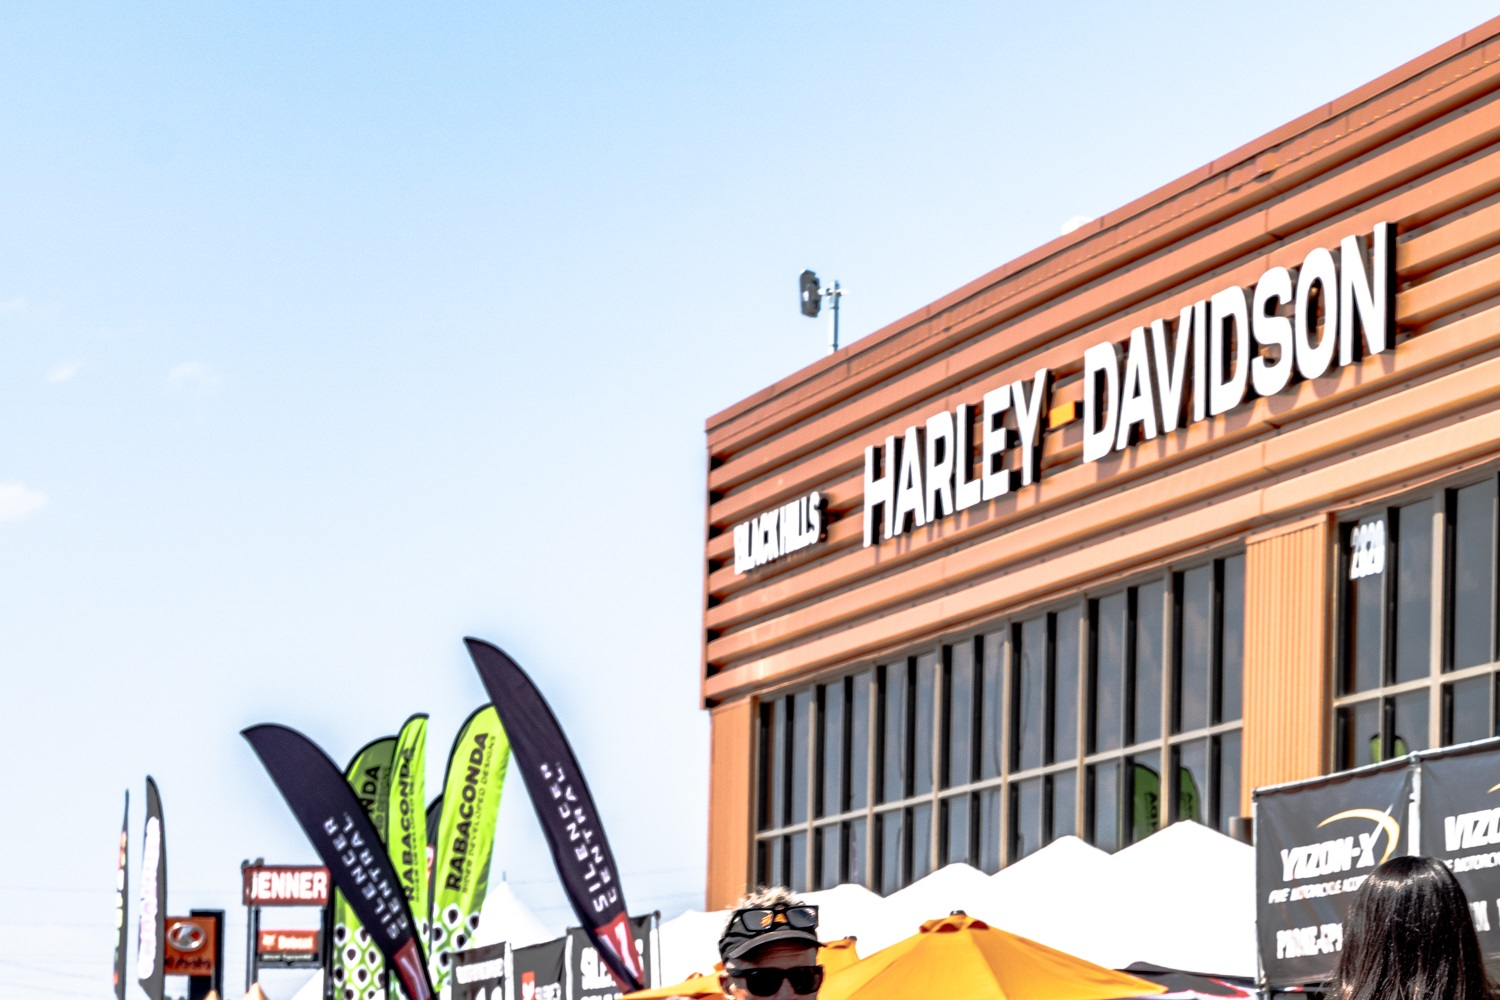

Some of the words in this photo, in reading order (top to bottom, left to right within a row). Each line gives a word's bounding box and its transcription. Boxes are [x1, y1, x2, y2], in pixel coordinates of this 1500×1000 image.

[734, 509, 779, 576] BLACK
[779, 490, 820, 557] HILLS
[445, 731, 489, 892] RABACONDA
[540, 763, 609, 912] SILENCER
[1280, 804, 1394, 882] VIZON-X
[251, 870, 328, 900] JENNER
[323, 816, 399, 940] SILENCER
